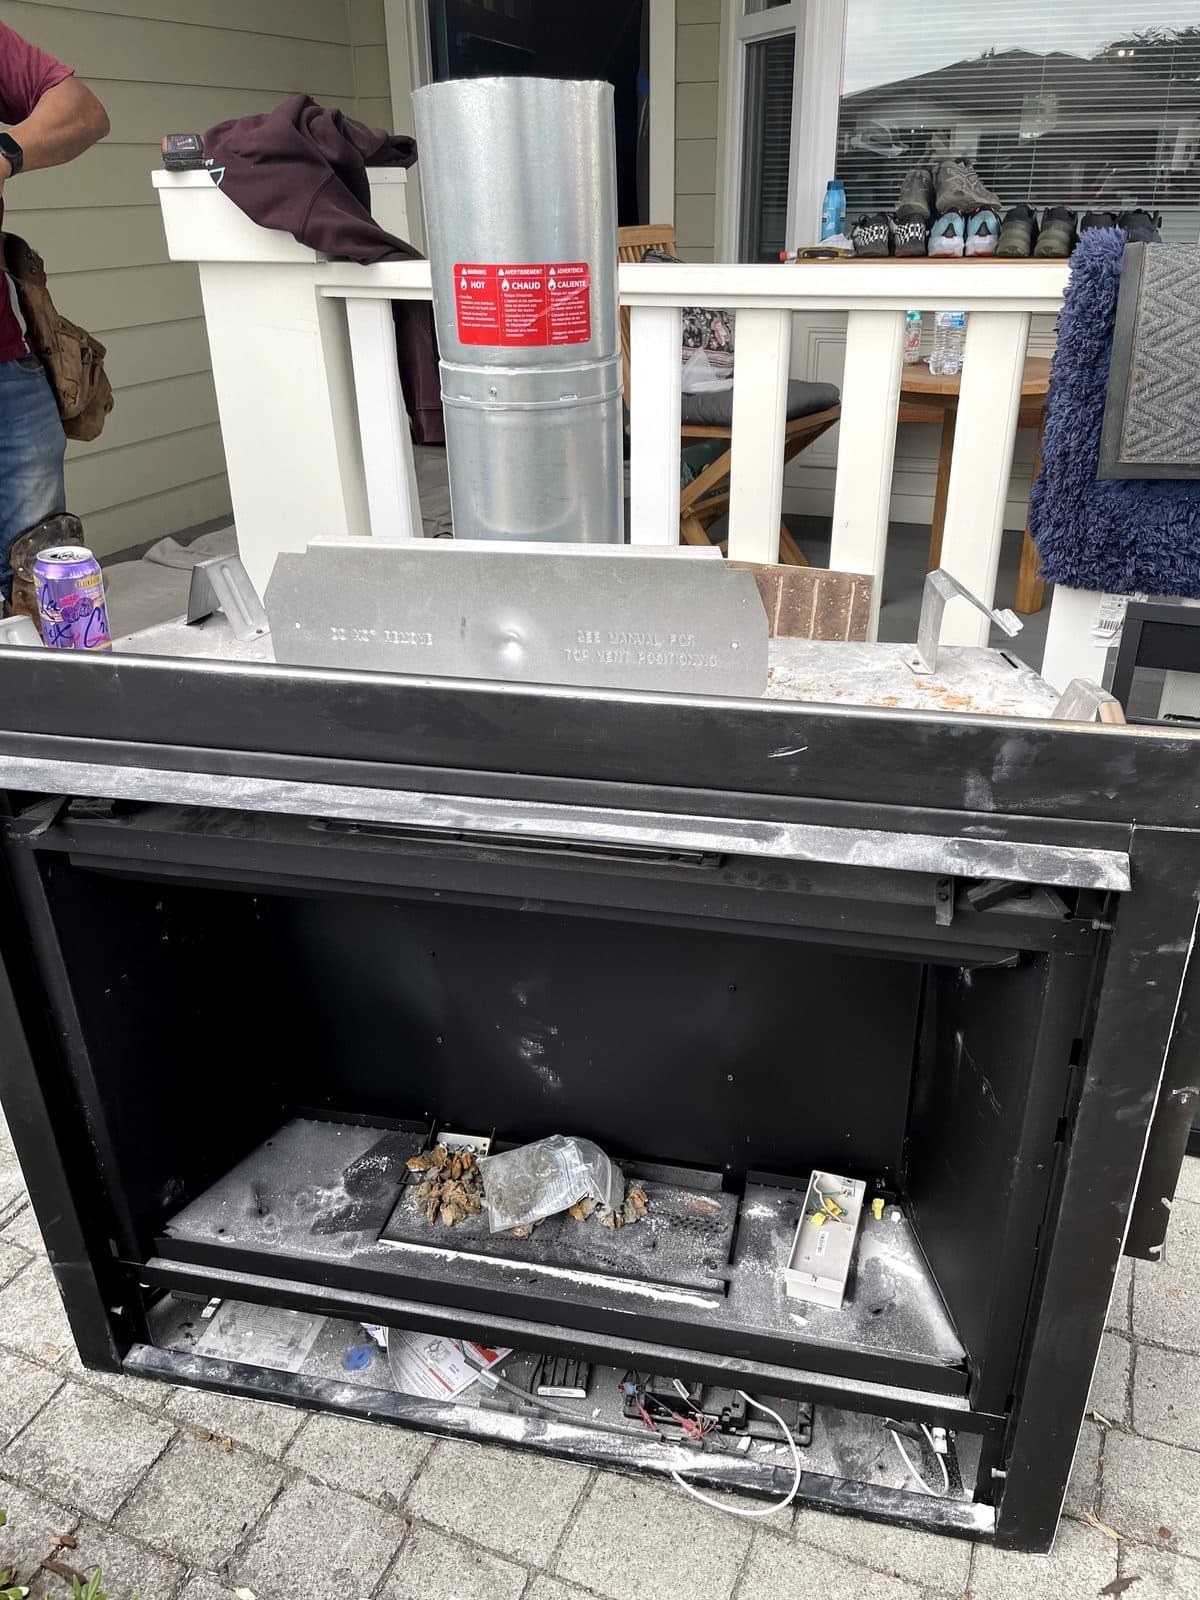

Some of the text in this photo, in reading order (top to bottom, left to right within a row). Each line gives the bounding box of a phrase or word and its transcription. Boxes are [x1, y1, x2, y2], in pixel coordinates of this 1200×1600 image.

[470, 281, 486, 289] HOT
[511, 281, 541, 290] CHAUD
[557, 280, 586, 289] CALIENTE
[576, 630, 696, 647] SEE MANUAL FOR
[564, 648, 719, 668] TOP VENT POSITIONING
